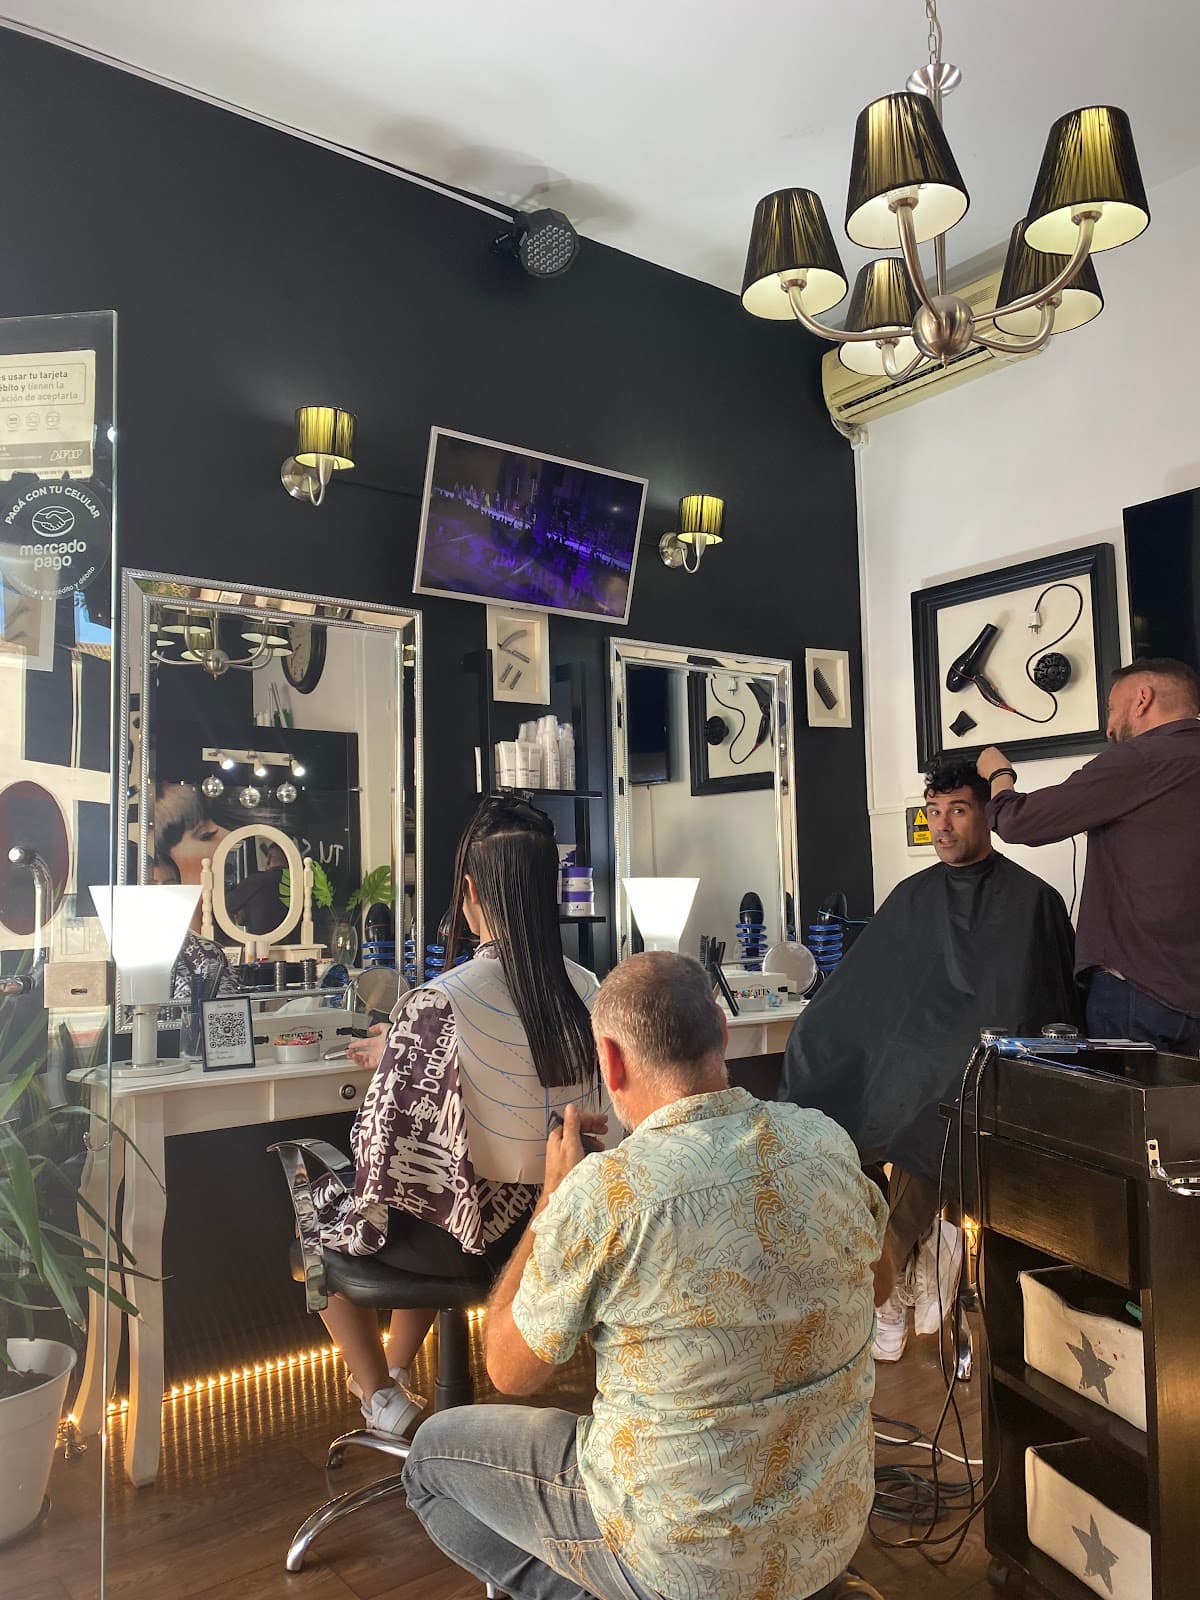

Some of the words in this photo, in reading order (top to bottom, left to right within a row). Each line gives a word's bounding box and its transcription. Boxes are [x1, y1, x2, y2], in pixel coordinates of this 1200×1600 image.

[29, 372, 38, 380] tu
[39, 370, 68, 380] tarjeta
[20, 384, 26, 392] y
[24, 392, 36, 401] de
[4, 498, 27, 525] PAGÁ
[25, 486, 47, 502] CON
[48, 485, 63, 494] TU
[64, 487, 101, 519] CELULAR
[19, 539, 87, 556] mercado
[33, 555, 72, 572] pago
